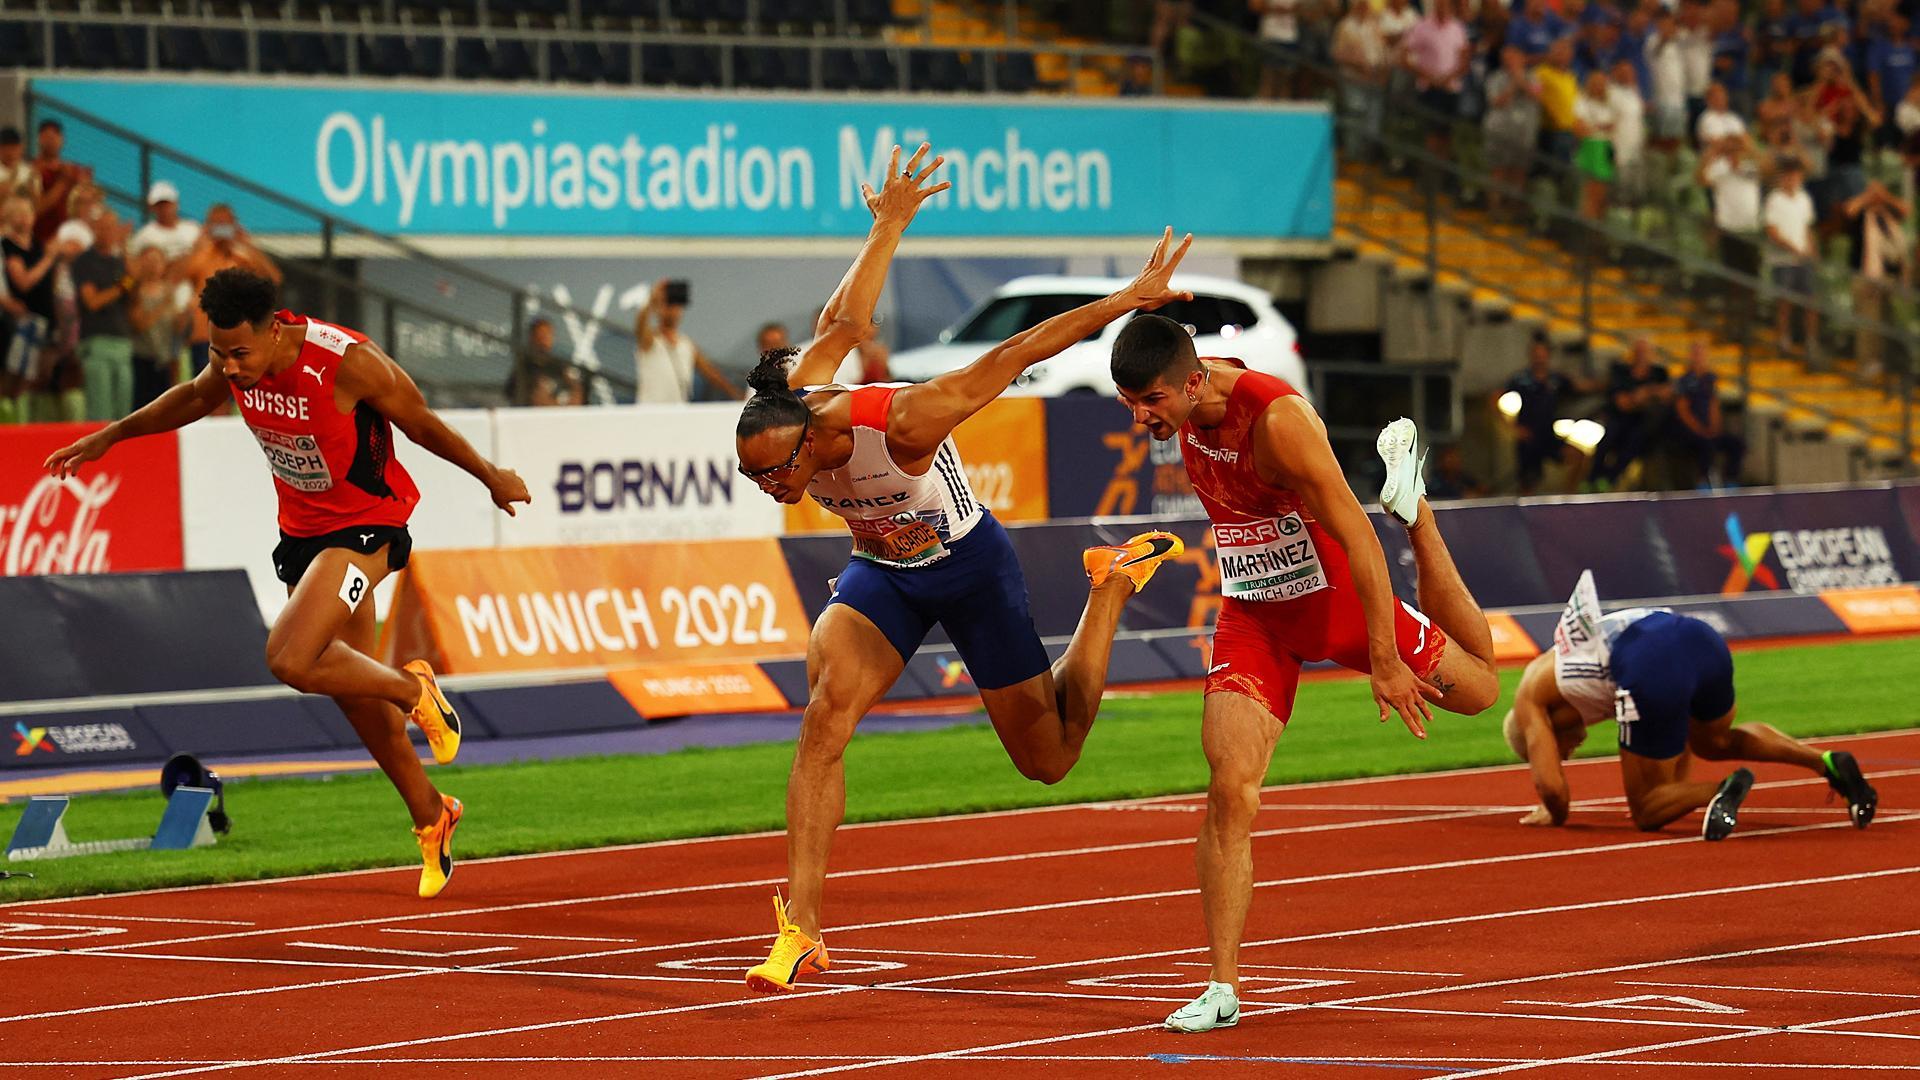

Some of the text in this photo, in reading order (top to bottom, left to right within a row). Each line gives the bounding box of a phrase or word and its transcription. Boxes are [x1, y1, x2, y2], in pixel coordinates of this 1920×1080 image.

[316, 111, 815, 228] Olympiastadion
[263, 445, 324, 470] OSEPH
[553, 458, 734, 513] BORNAN
[810, 491, 911, 508] FRANCE
[1217, 525, 1277, 544] SPAR
[1221, 539, 1314, 579] MARTÍNEZ
[348, 577, 364, 603] 8
[1250, 579, 1267, 588] RUN
[1286, 576, 1321, 596] 2022
[455, 582, 788, 658] MUNICH 2022
